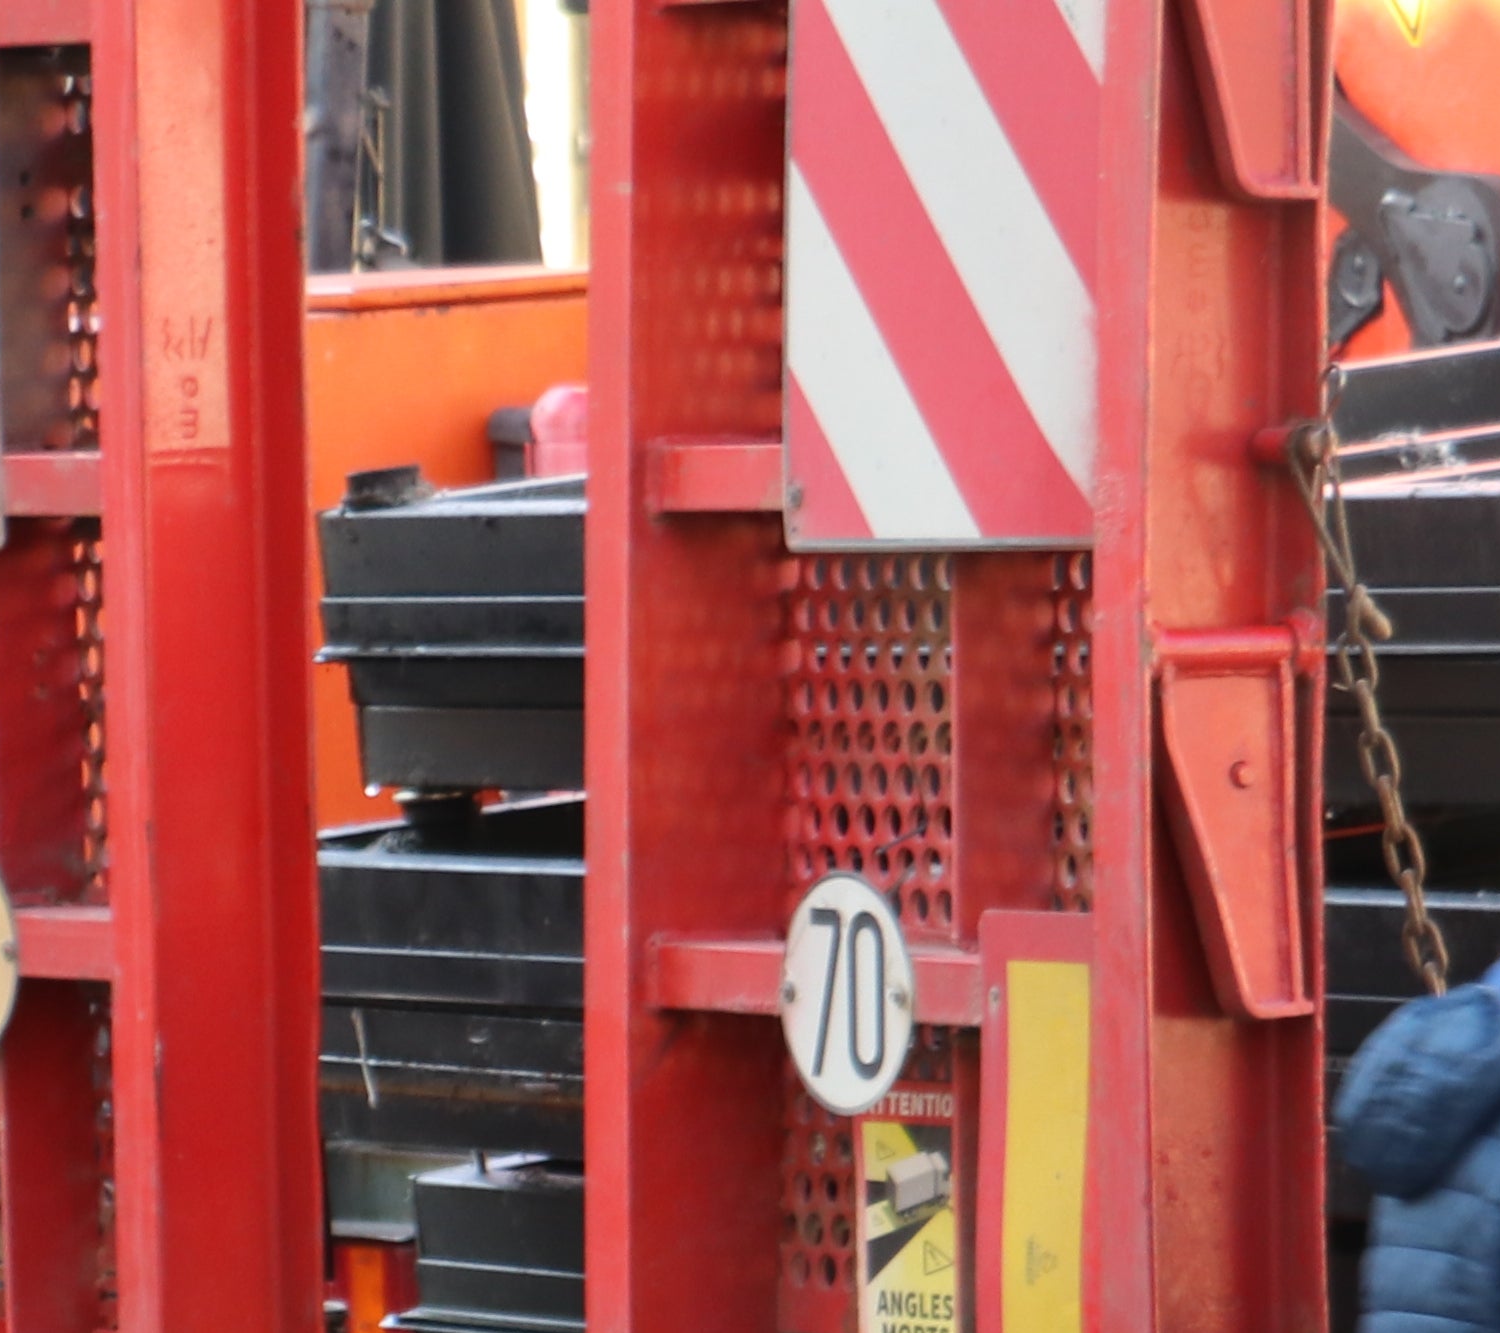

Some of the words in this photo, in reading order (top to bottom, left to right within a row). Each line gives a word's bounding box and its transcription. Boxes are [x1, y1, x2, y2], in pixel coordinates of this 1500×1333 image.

[810, 907, 886, 1081] 70
[866, 1090, 953, 1118] TTENTIO
[877, 1290, 954, 1320] ANGLES
